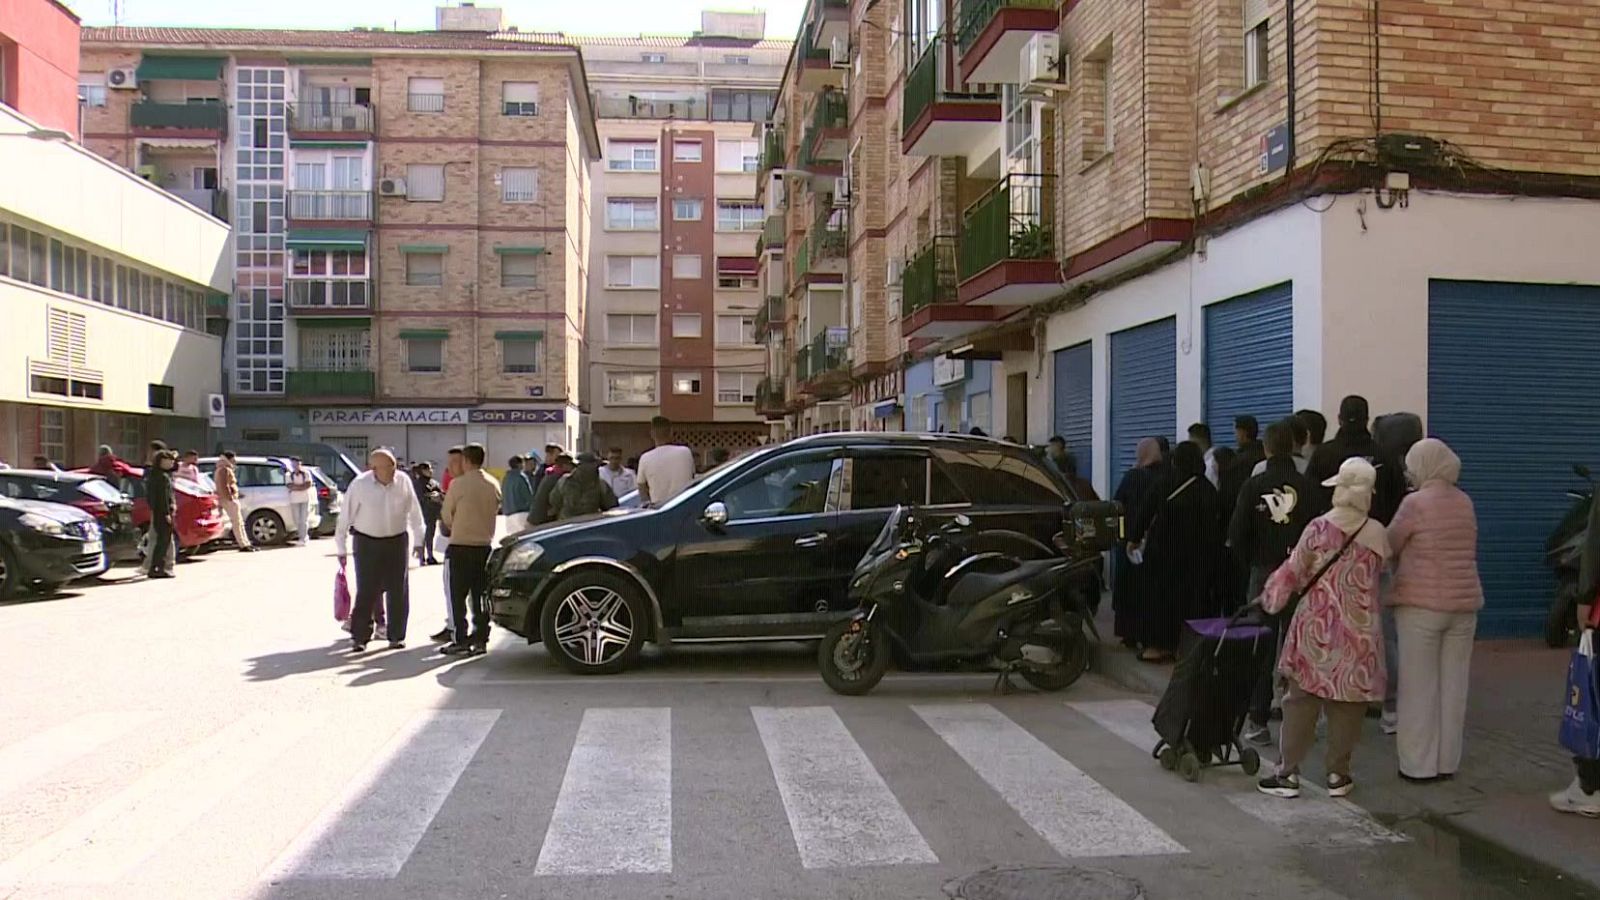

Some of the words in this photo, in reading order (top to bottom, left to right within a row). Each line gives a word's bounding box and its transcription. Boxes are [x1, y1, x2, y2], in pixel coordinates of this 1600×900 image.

[312, 410, 462, 422] PARAFARMACIA
[471, 410, 505, 421] San
[510, 410, 537, 421] Pio
[543, 410, 557, 421] X
